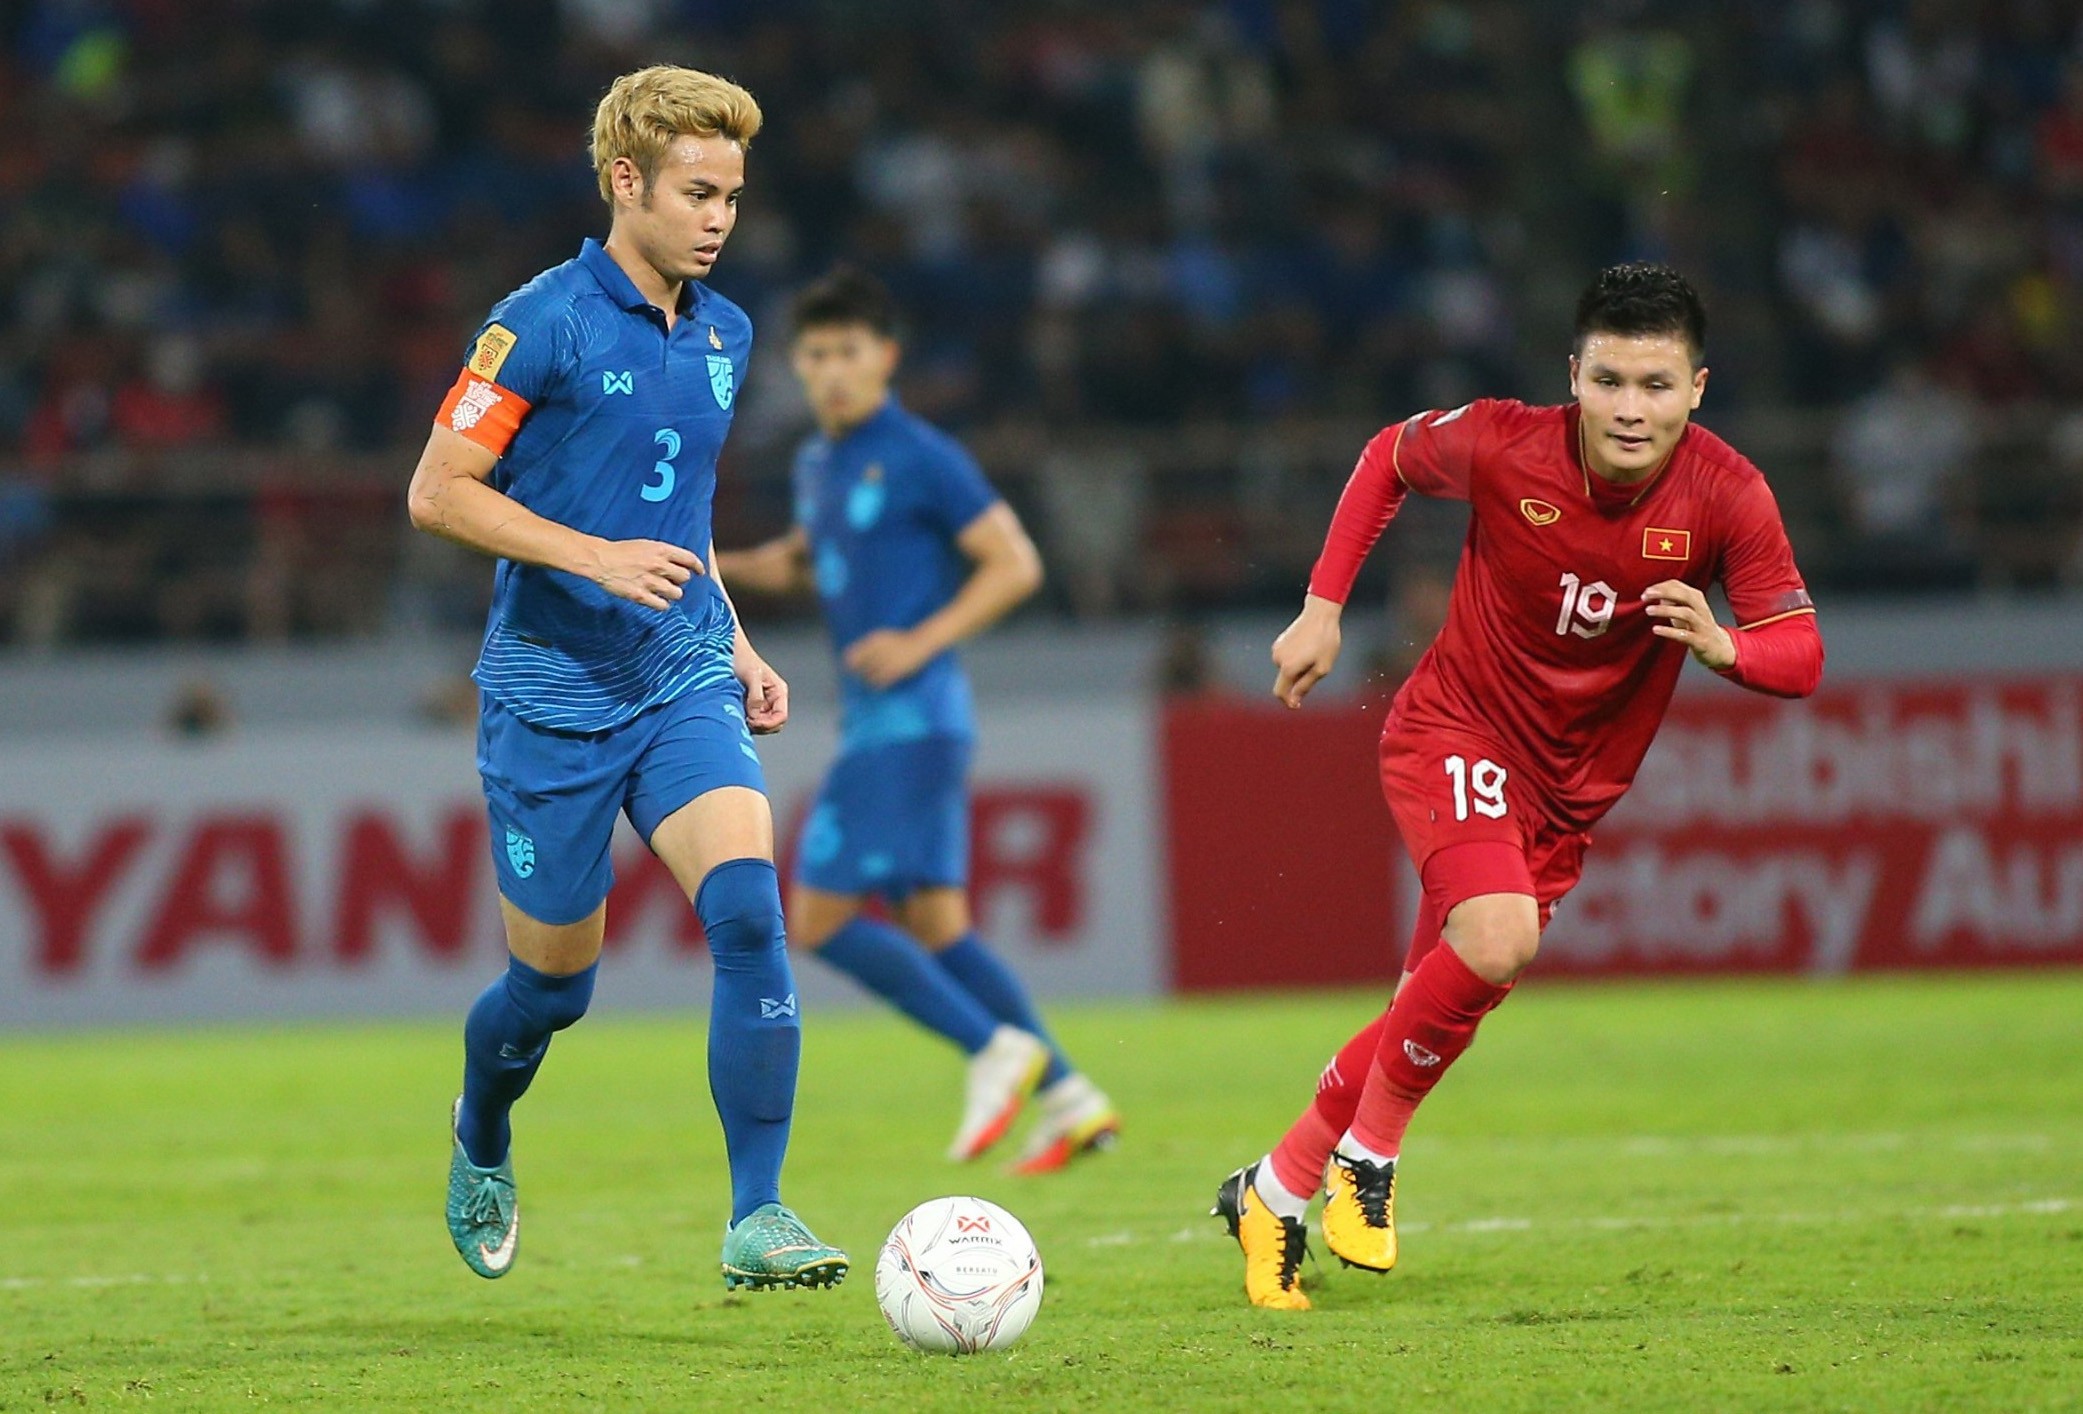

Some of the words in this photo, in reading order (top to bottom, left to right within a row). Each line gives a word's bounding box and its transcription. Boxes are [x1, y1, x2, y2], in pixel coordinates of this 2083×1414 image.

[640, 428, 682, 502] 3
[1556, 572, 1618, 639] 19
[1444, 754, 1507, 821] 19
[0, 782, 1090, 976] YANR
[948, 1236, 1003, 1246] WARRIX
